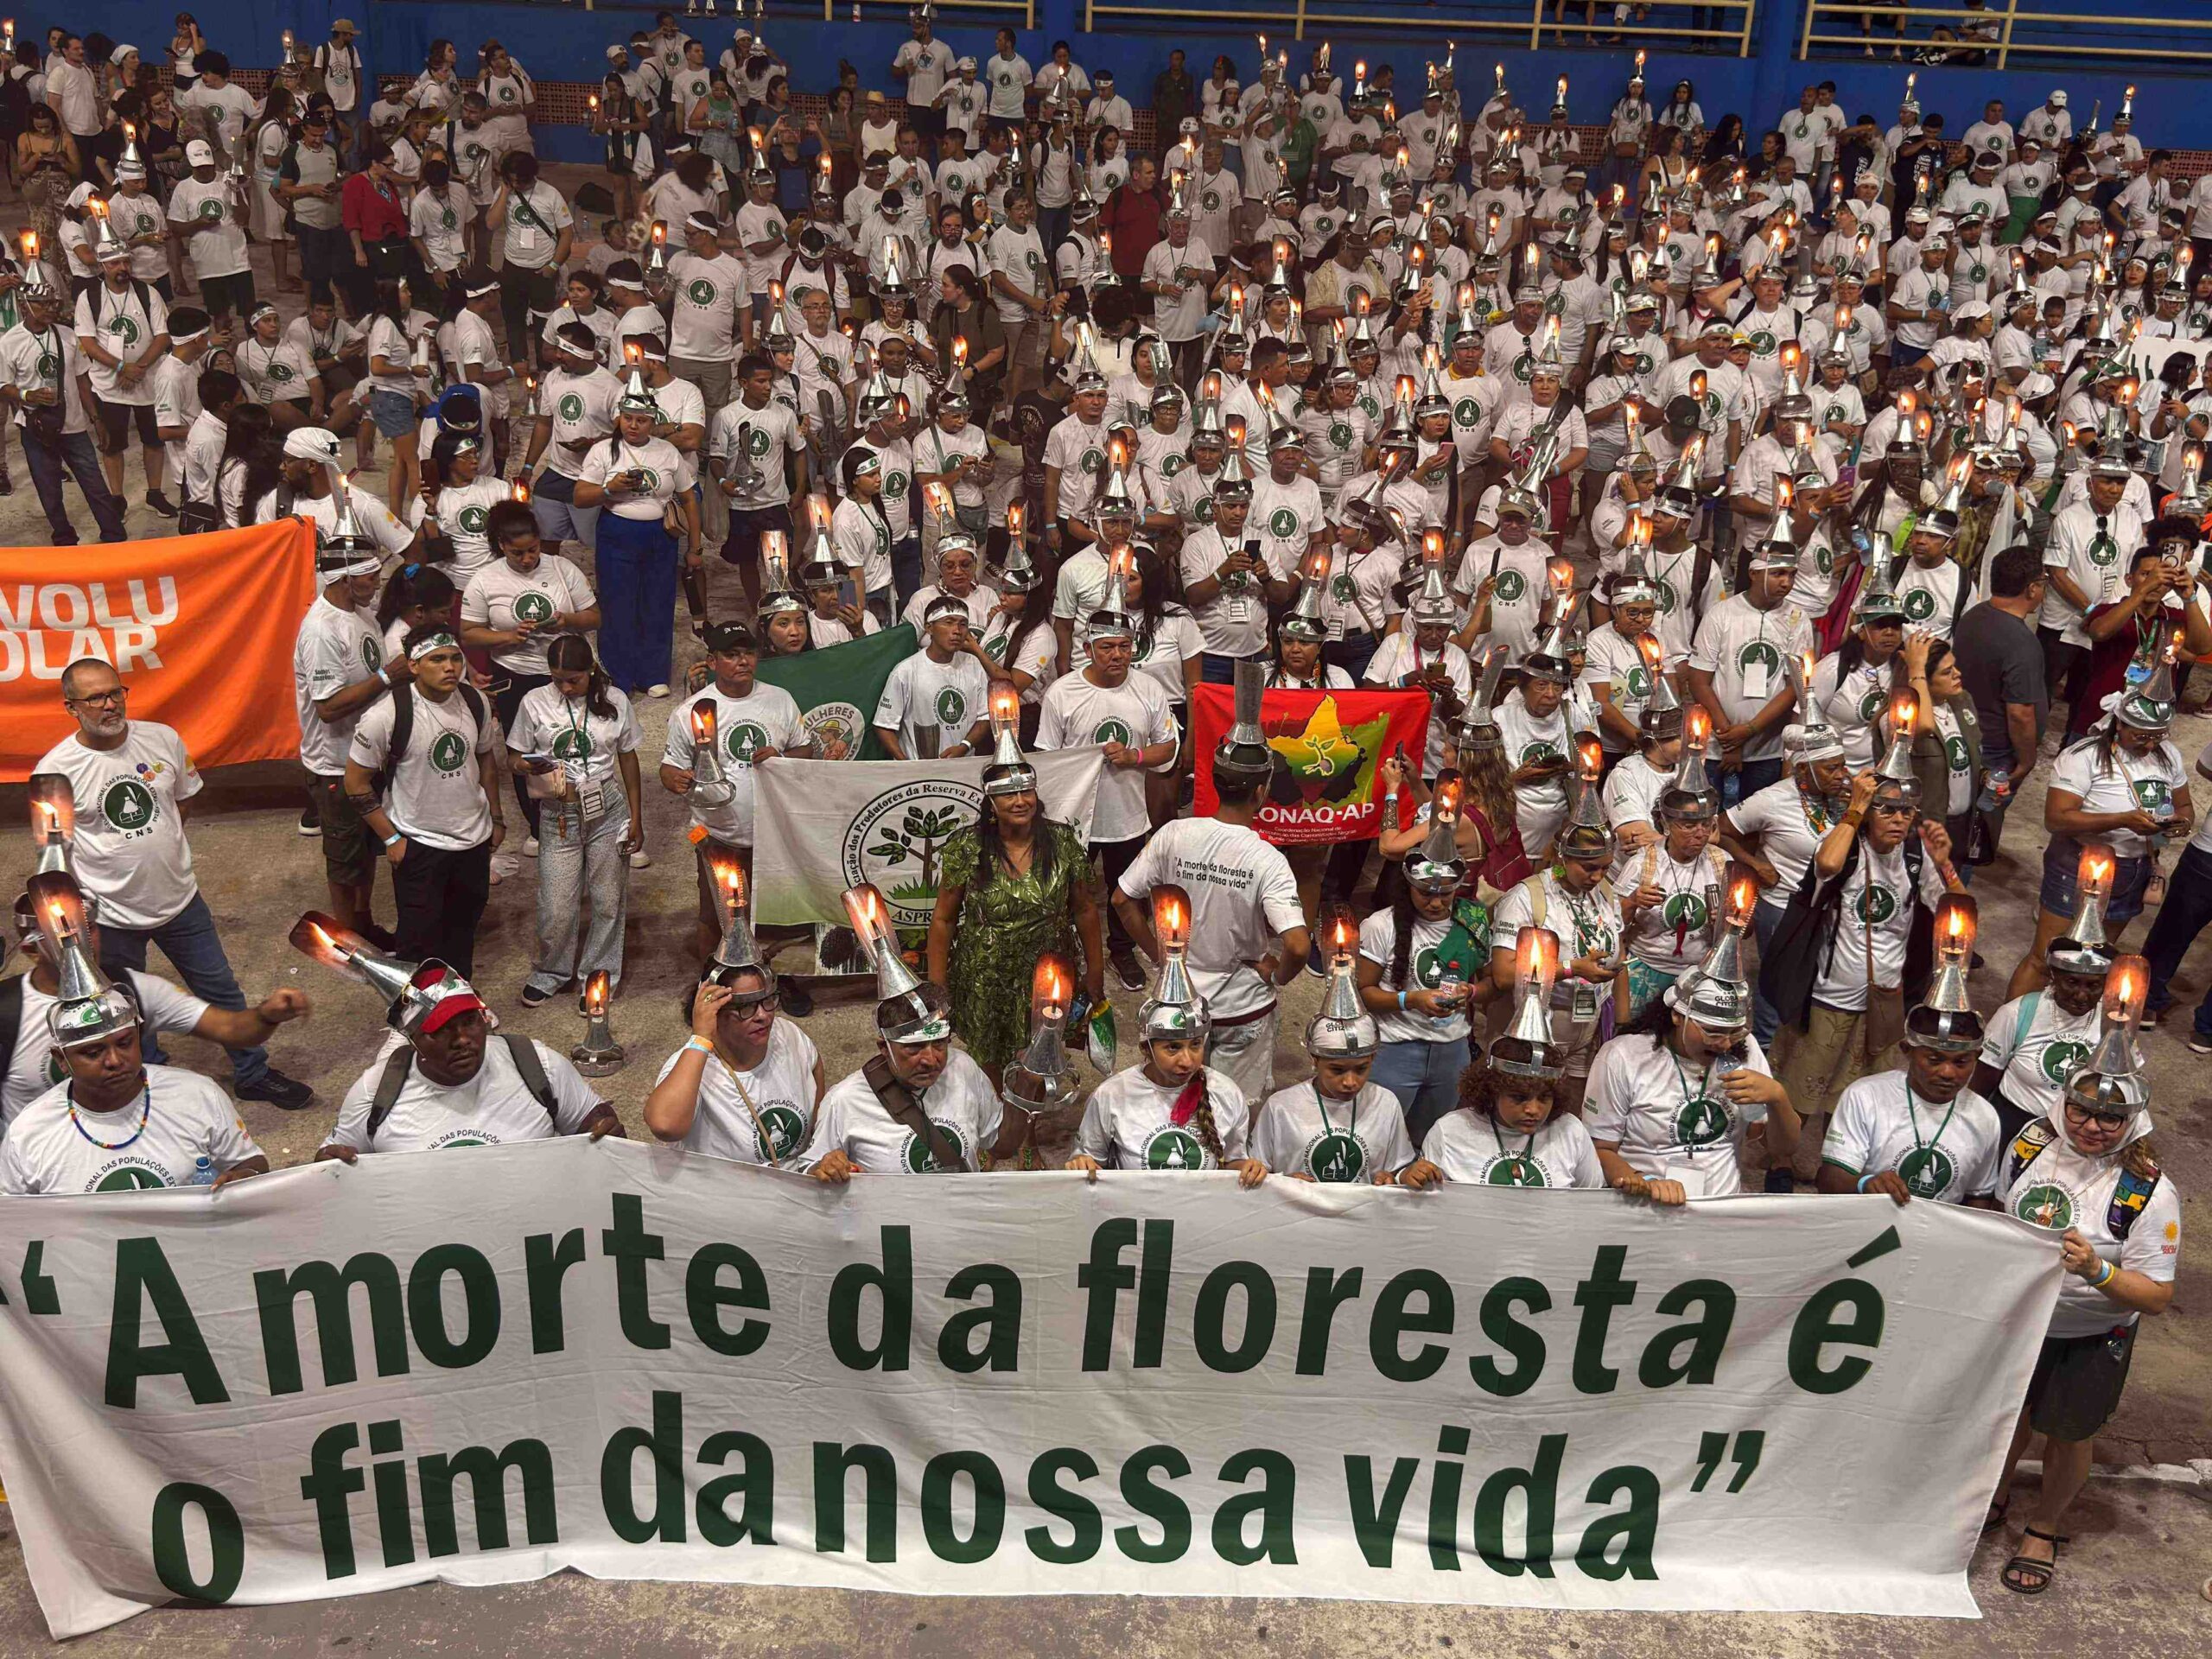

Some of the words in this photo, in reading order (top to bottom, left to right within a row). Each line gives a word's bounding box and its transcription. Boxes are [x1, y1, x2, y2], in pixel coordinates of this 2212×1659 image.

[848, 833, 860, 850] dos
[855, 791, 904, 834] Produtores
[906, 786, 920, 797] da
[923, 784, 966, 798] Reserva
[1252, 803, 1375, 823] ONAQ-AP
[125, 827, 153, 839] CNS
[1182, 870, 1194, 880] fim
[1196, 873, 1207, 881] da
[1209, 874, 1227, 886] nossa
[1185, 861, 1207, 871] morte
[1210, 863, 1217, 872] da
[1218, 864, 1247, 878] floresta
[893, 909, 931, 923] ASPR
[440, 1131, 455, 1143] DAS
[456, 1128, 501, 1145] POPULAÇÕE
[101, 1160, 118, 1174] DAS
[118, 1156, 169, 1179] POPULAÇÕES
[253, 1192, 771, 1396] morte
[828, 1225, 1022, 1373] da
[1078, 1218, 1737, 1397] floresta
[1788, 1225, 1901, 1395] é
[151, 1482, 245, 1604] o
[301, 1420, 558, 1580] fim
